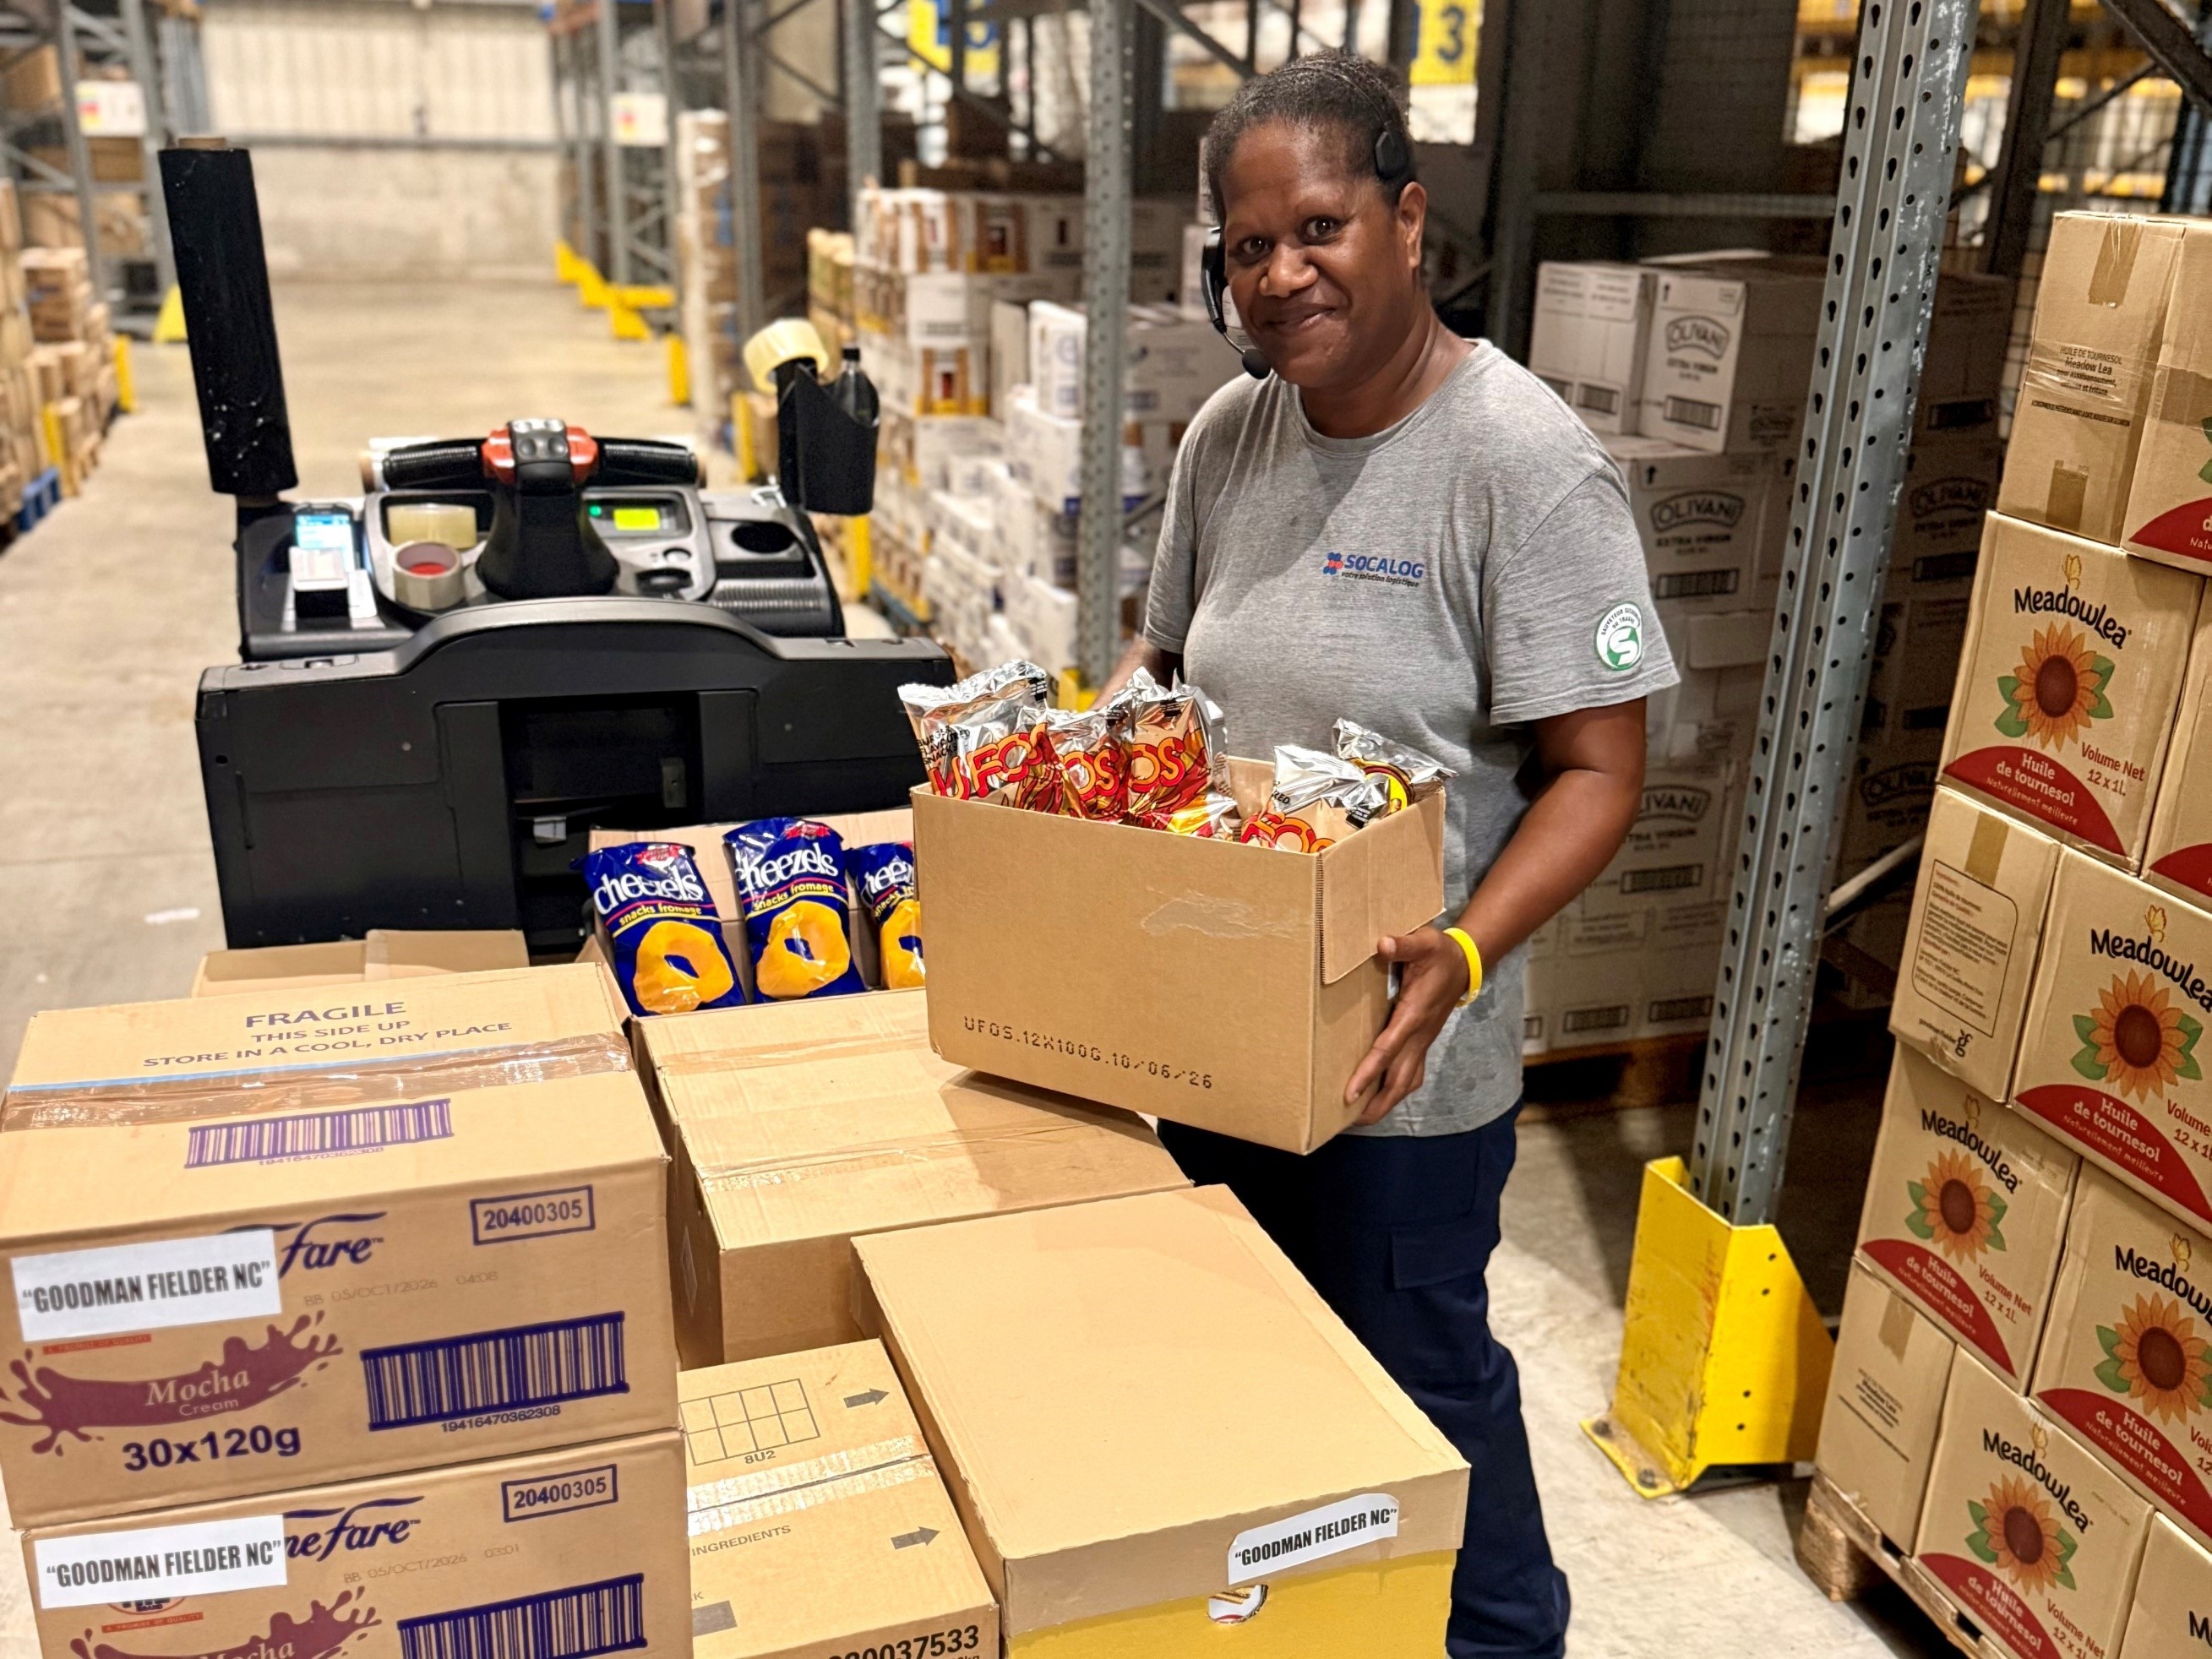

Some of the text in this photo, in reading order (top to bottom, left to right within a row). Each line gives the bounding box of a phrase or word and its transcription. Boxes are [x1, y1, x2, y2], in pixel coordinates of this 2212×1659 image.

[1437, 5, 1465, 64] 3
[2065, 357, 2112, 375] Meadow Lea
[2079, 348, 2087, 357] DE
[2087, 351, 2122, 364] TOURNESOL
[1344, 554, 1425, 579] SOCALOG
[1358, 573, 1385, 582] solution
[1386, 575, 1419, 588] logistique
[2014, 585, 2127, 650] MeadowLea
[2021, 753, 2056, 781] Huile
[2081, 742, 2145, 782] Volume Net
[1997, 761, 2075, 807] de tournesol
[2087, 769, 2102, 786] 12
[2102, 777, 2111, 789] x
[1986, 775, 2078, 826] Naturellement meilleure
[735, 842, 839, 896] cheezels
[755, 881, 835, 911] snacks fromage
[619, 901, 703, 927] snacks fromage
[245, 1001, 407, 1028] FRAGILE
[143, 1022, 513, 1068] STORE IN A COOL, DRY PLACE
[251, 1020, 411, 1043] THIS SIDE UP
[2101, 1097, 2138, 1131] Huile
[2167, 1099, 2212, 1137] Volume
[2073, 1101, 2161, 1162] de tournesol
[2173, 1129, 2190, 1146] 12
[2191, 1140, 2199, 1153] x
[1921, 1107, 2019, 1194] MeadowLea
[482, 1199, 584, 1232] 20400305
[146, 1265, 230, 1301] FIELDER
[1905, 1256, 1975, 1319] de tournesol
[1927, 1254, 1958, 1289] Huile
[304, 1294, 324, 1307] BB
[331, 1278, 439, 1303] 05/OCT/2026
[1978, 1265, 2033, 1317] Volume Net
[1984, 1290, 1996, 1308] 12
[144, 1369, 251, 1406] Mocha
[178, 1399, 239, 1417] Cream
[441, 1404, 562, 1433] 19416470362308
[122, 1424, 302, 1471] 30x120g
[2122, 1412, 2161, 1450] Huile
[744, 1450, 776, 1465] 8U2
[2095, 1410, 2183, 1486] de tournesol
[513, 1477, 607, 1509] 20400305
[1983, 1428, 2089, 1535] MeadowLea
[691, 1524, 792, 1557] INGREDIENTS
[1315, 1512, 1367, 1544] FIELDER
[164, 1545, 242, 1577] FIELDER
[344, 1571, 362, 1584] BB
[367, 1553, 467, 1579] 05/OCT/2026
[1991, 1580, 2024, 1617] Huile
[1985, 1590, 2043, 1651] tournesol
[2047, 1598, 2106, 1659] Volume Net
[2052, 1626, 2067, 1644] 12
[2068, 1640, 2076, 1652] x
